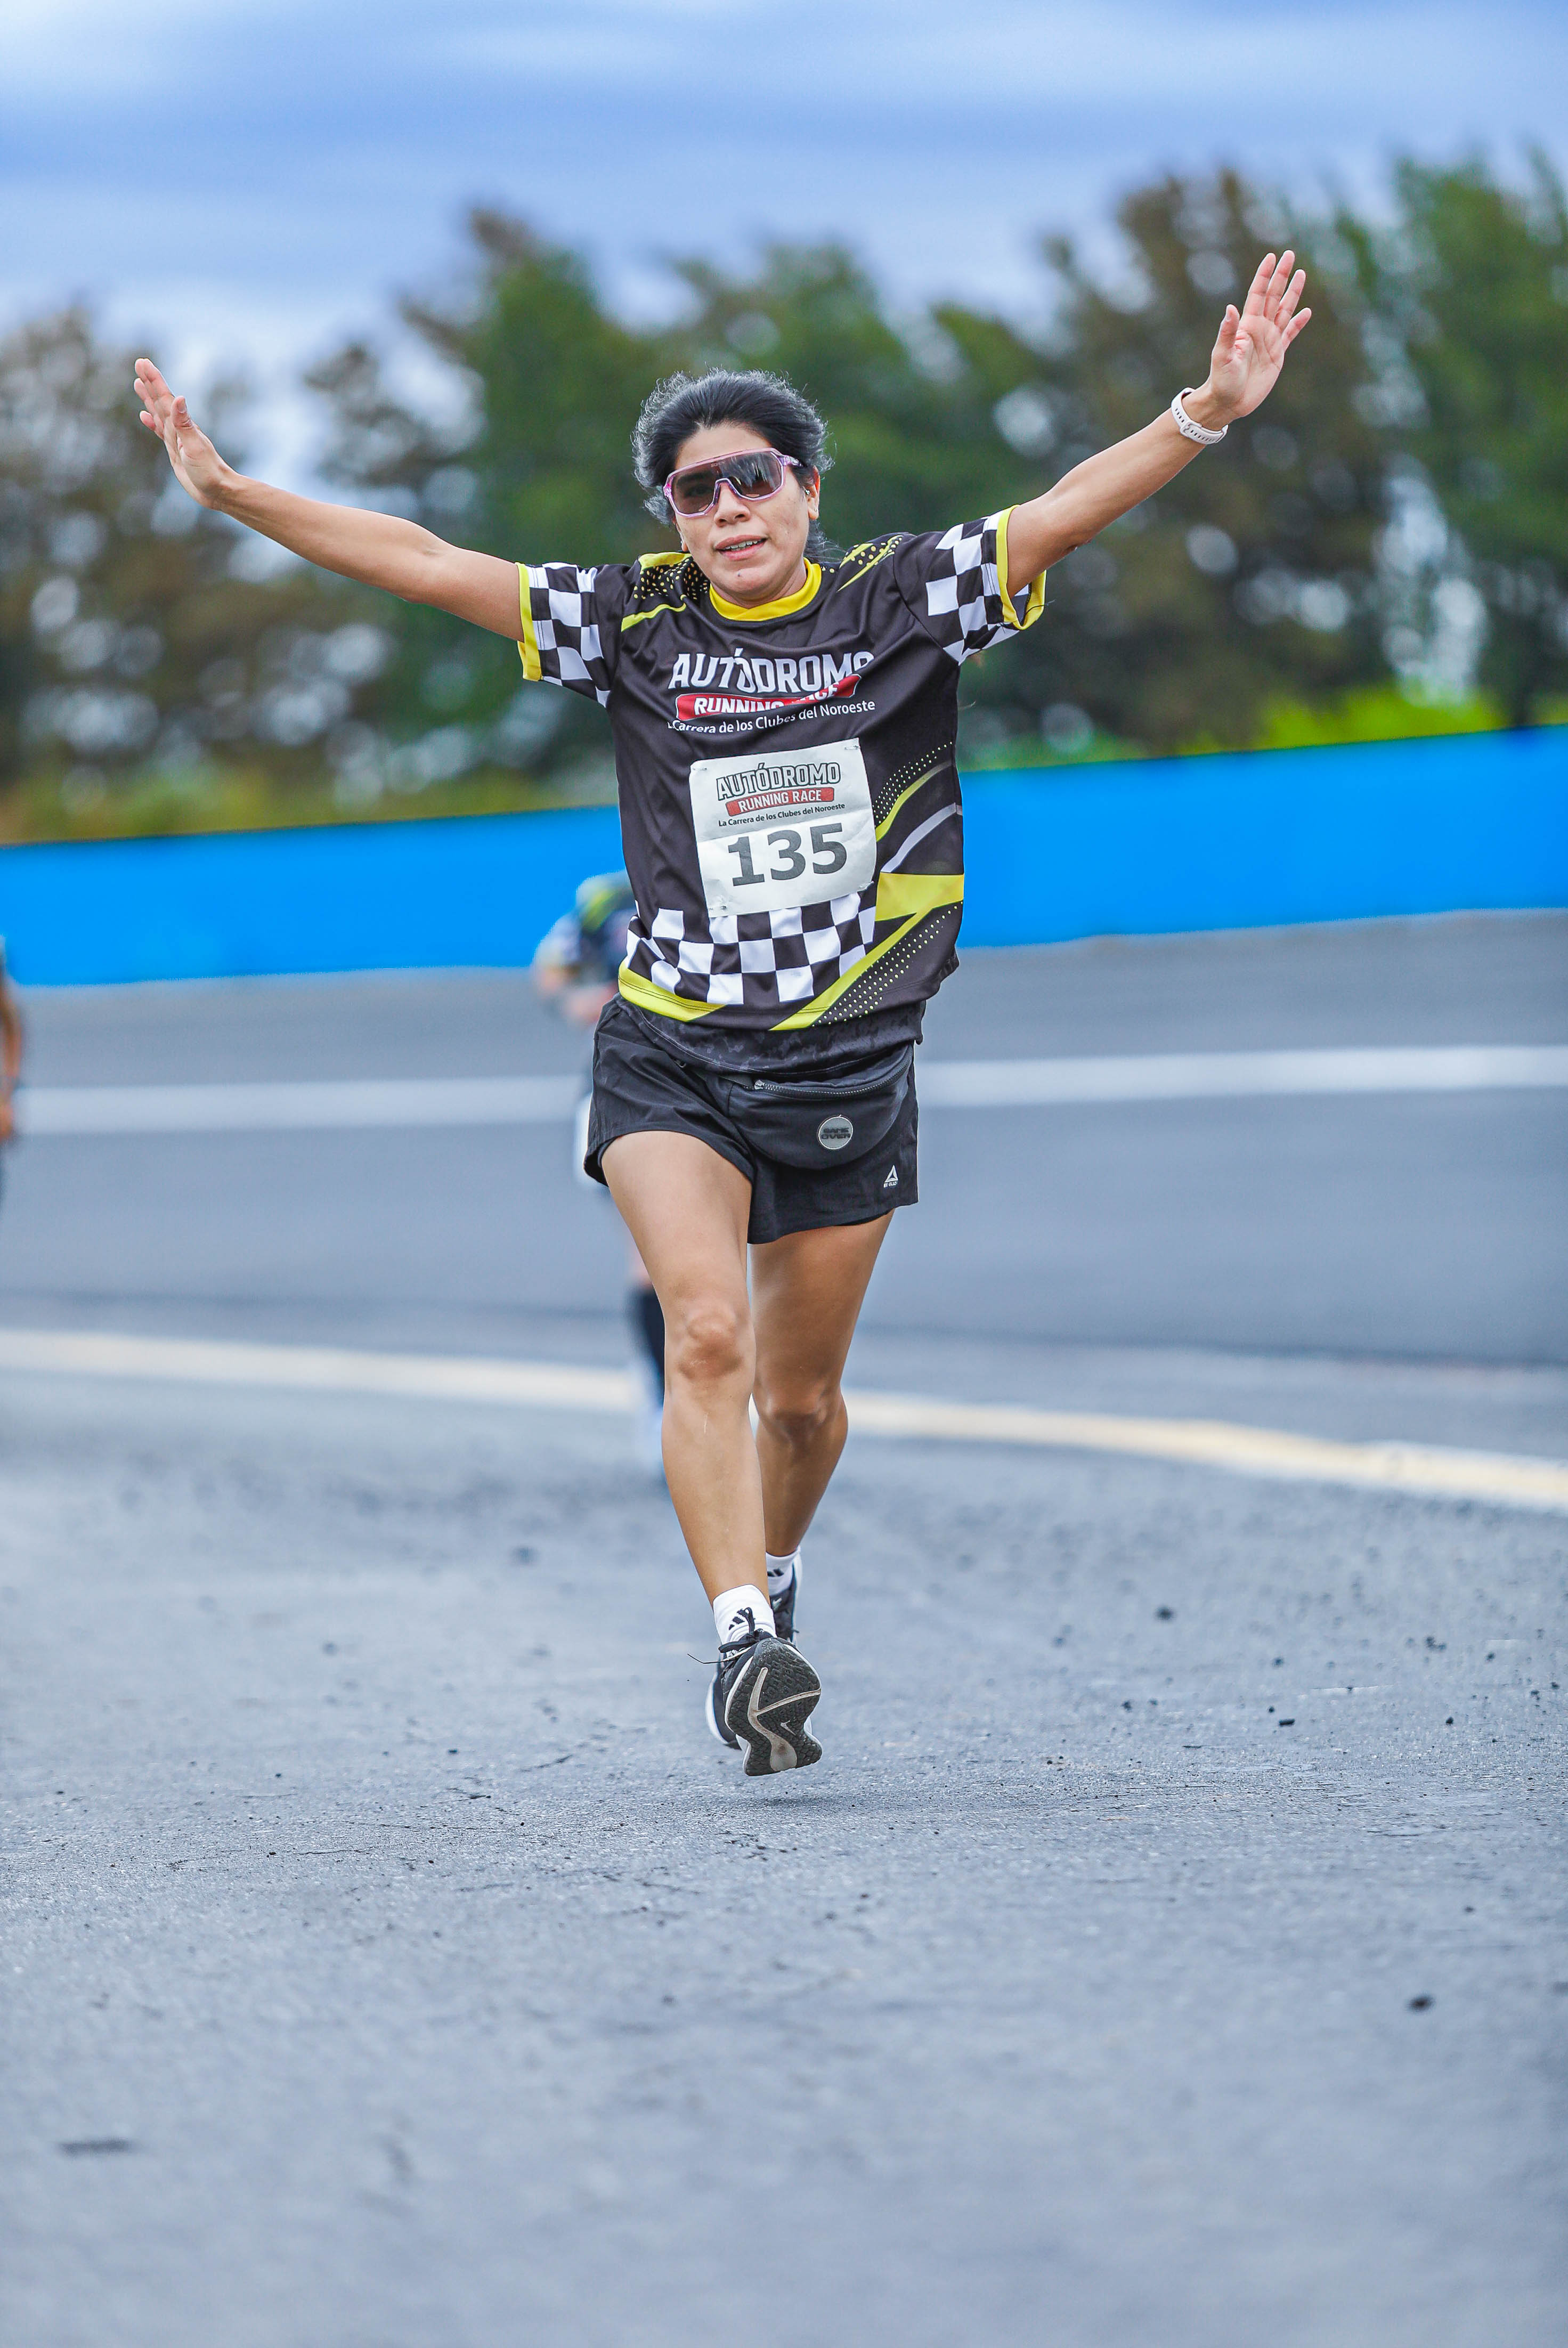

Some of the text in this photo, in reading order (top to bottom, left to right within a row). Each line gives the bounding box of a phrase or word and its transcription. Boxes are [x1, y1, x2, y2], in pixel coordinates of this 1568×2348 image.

[672, 720, 716, 733] Carrera
[719, 721, 734, 733] de
[736, 720, 753, 732] los
[755, 714, 795, 729] Clubes
[799, 706, 818, 720] del
[820, 700, 875, 717] Noroeste
[716, 762, 841, 801] AUTÓDROMO
[737, 790, 822, 813] RUNNING RACE
[815, 803, 846, 813] Noroeste
[728, 823, 847, 887] 135
